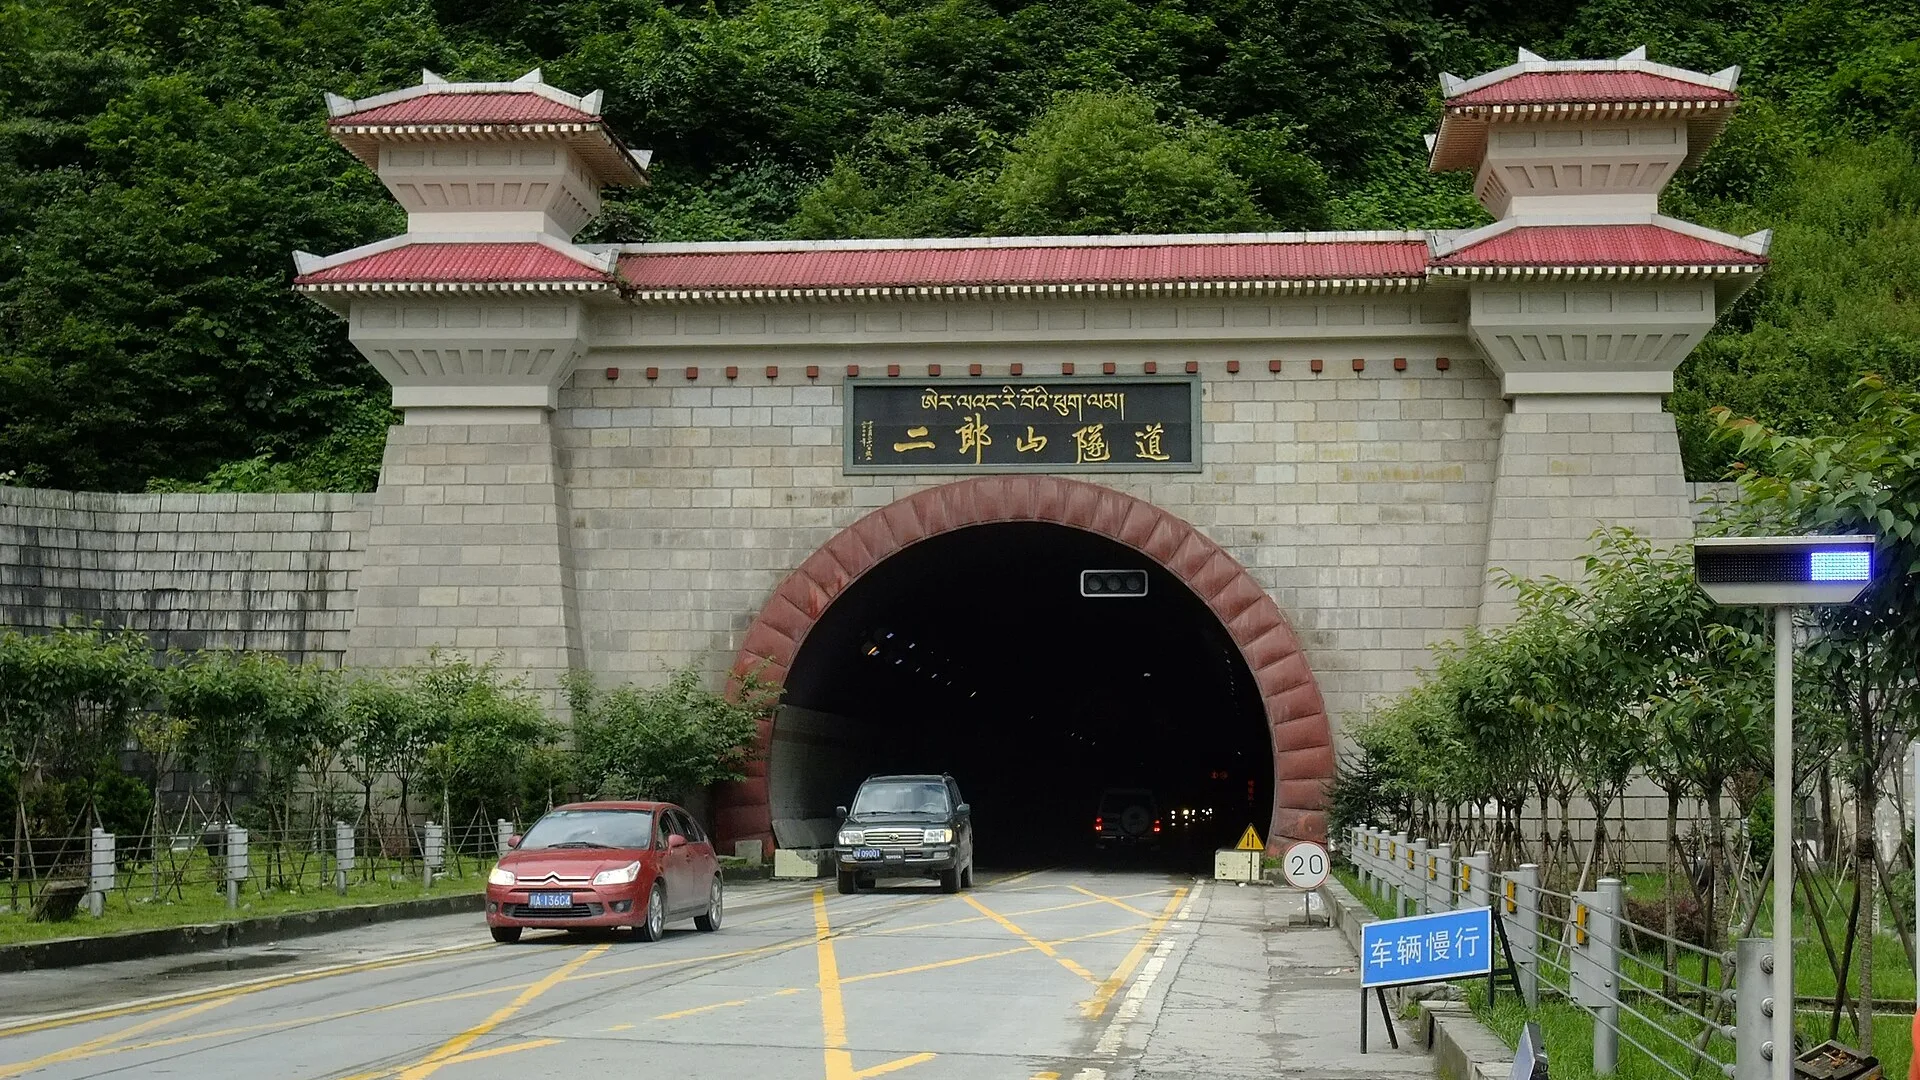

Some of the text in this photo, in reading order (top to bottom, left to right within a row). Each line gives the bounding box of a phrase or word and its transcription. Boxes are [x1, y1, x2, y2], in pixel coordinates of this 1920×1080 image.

[893, 412, 1171, 465] 二郎山隧道
[1291, 854, 1323, 876] 20
[1370, 926, 1480, 969] 车辆慢行
